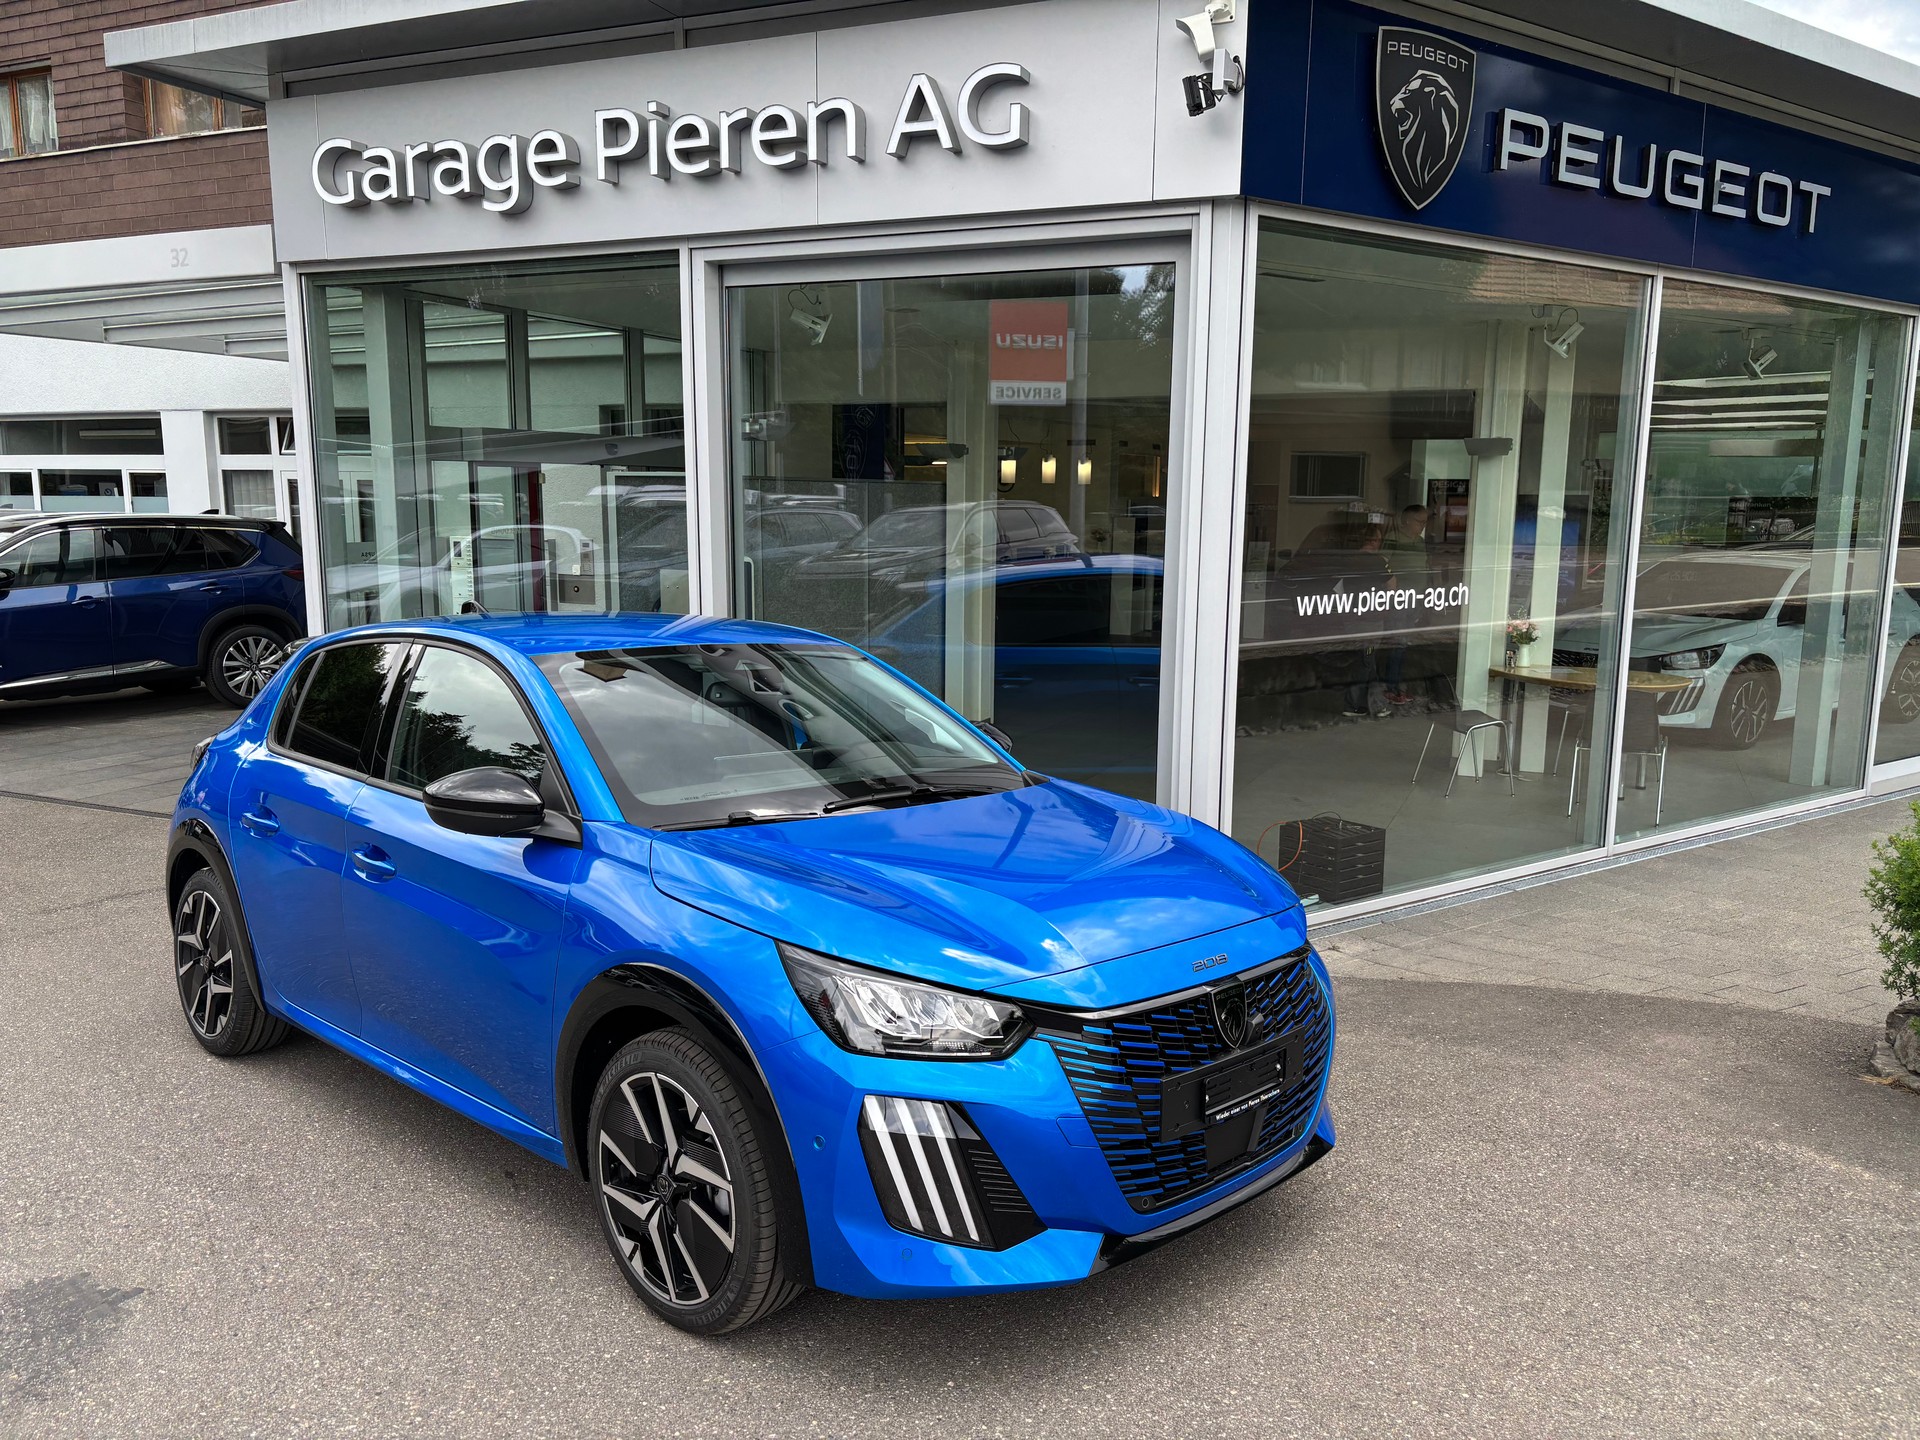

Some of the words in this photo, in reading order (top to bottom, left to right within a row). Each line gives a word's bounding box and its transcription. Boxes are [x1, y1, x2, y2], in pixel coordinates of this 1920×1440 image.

[1387, 41, 1469, 72] PEUGEOT
[311, 130, 579, 214] Garage
[594, 100, 865, 184] Pieren
[885, 61, 1030, 159] AG
[1496, 107, 1831, 233] PEUGEOT
[170, 247, 190, 268] 32
[1297, 582, 1469, 616] www.pieren-ag.ch
[1192, 953, 1228, 972] 208
